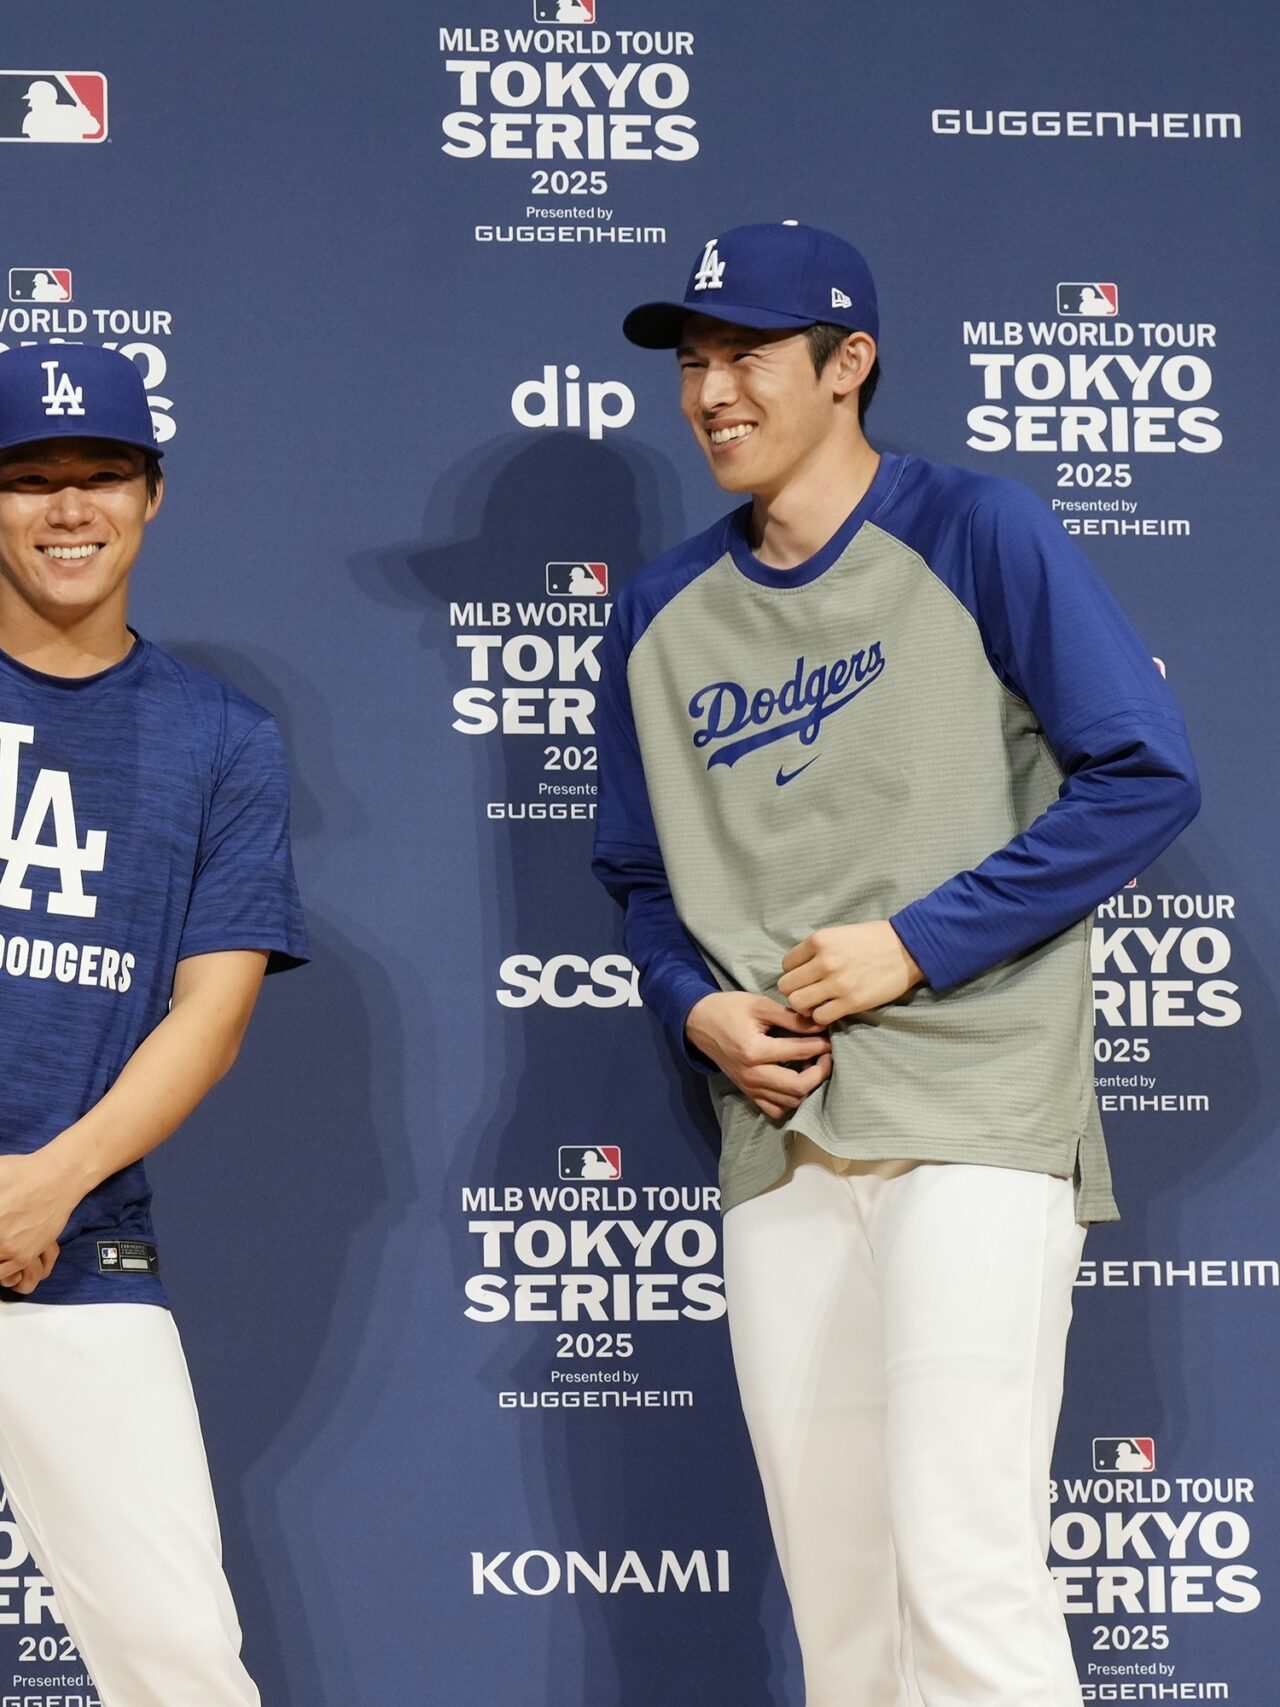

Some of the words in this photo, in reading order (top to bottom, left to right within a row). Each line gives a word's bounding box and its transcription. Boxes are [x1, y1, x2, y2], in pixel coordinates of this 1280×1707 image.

[439, 27, 500, 53] MLB
[503, 29, 611, 54] WORLD
[615, 30, 694, 56] TOUR
[445, 59, 690, 109] TOKYO
[441, 111, 700, 162] SERIES
[931, 109, 1242, 138] GUGGENHEIM
[531, 170, 608, 195] 2025
[526, 206, 595, 219] Presented
[597, 207, 614, 221] by
[475, 225, 666, 243] GUGGENHEIM
[694, 238, 726, 291] LA
[92, 309, 172, 335] TOUR
[963, 321, 1024, 346] MLB
[1027, 321, 1134, 347] WORLD
[1138, 323, 1217, 348] TOUR
[41, 360, 86, 416] LA
[969, 353, 1212, 402] TOKYO
[511, 364, 636, 440] dip
[966, 405, 1223, 454] SERIES
[1056, 462, 1132, 488] 2025
[1051, 498, 1120, 512] Presented
[1121, 499, 1138, 514] by
[449, 602, 512, 627] MLB
[688, 640, 886, 748] Dodgers
[451, 687, 596, 735] SER
[1156, 894, 1235, 919] TOUR
[1140, 1074, 1156, 1089] by
[1095, 1094, 1210, 1112] ENHEIM
[461, 1187, 524, 1212] MLB
[528, 1186, 637, 1212] WORLD
[642, 1186, 722, 1211] TOUR
[468, 1219, 717, 1268] TOKYO
[461, 1271, 727, 1324] SERIES
[556, 1333, 634, 1358] 2025
[551, 1370, 620, 1383] Presented
[622, 1370, 639, 1385] by
[498, 1390, 693, 1409] GUGGENHEIM
[1063, 1478, 1171, 1504] WORLD
[1175, 1477, 1254, 1503] TOUR
[1050, 1510, 1251, 1560] OKYO
[470, 1549, 730, 1596] KONAMI
[17, 1636, 84, 1662] 202
[1092, 1624, 1170, 1651] 2025
[13, 1674, 84, 1687] Presented
[1087, 1662, 1157, 1676] Presented
[1158, 1662, 1175, 1677] by
